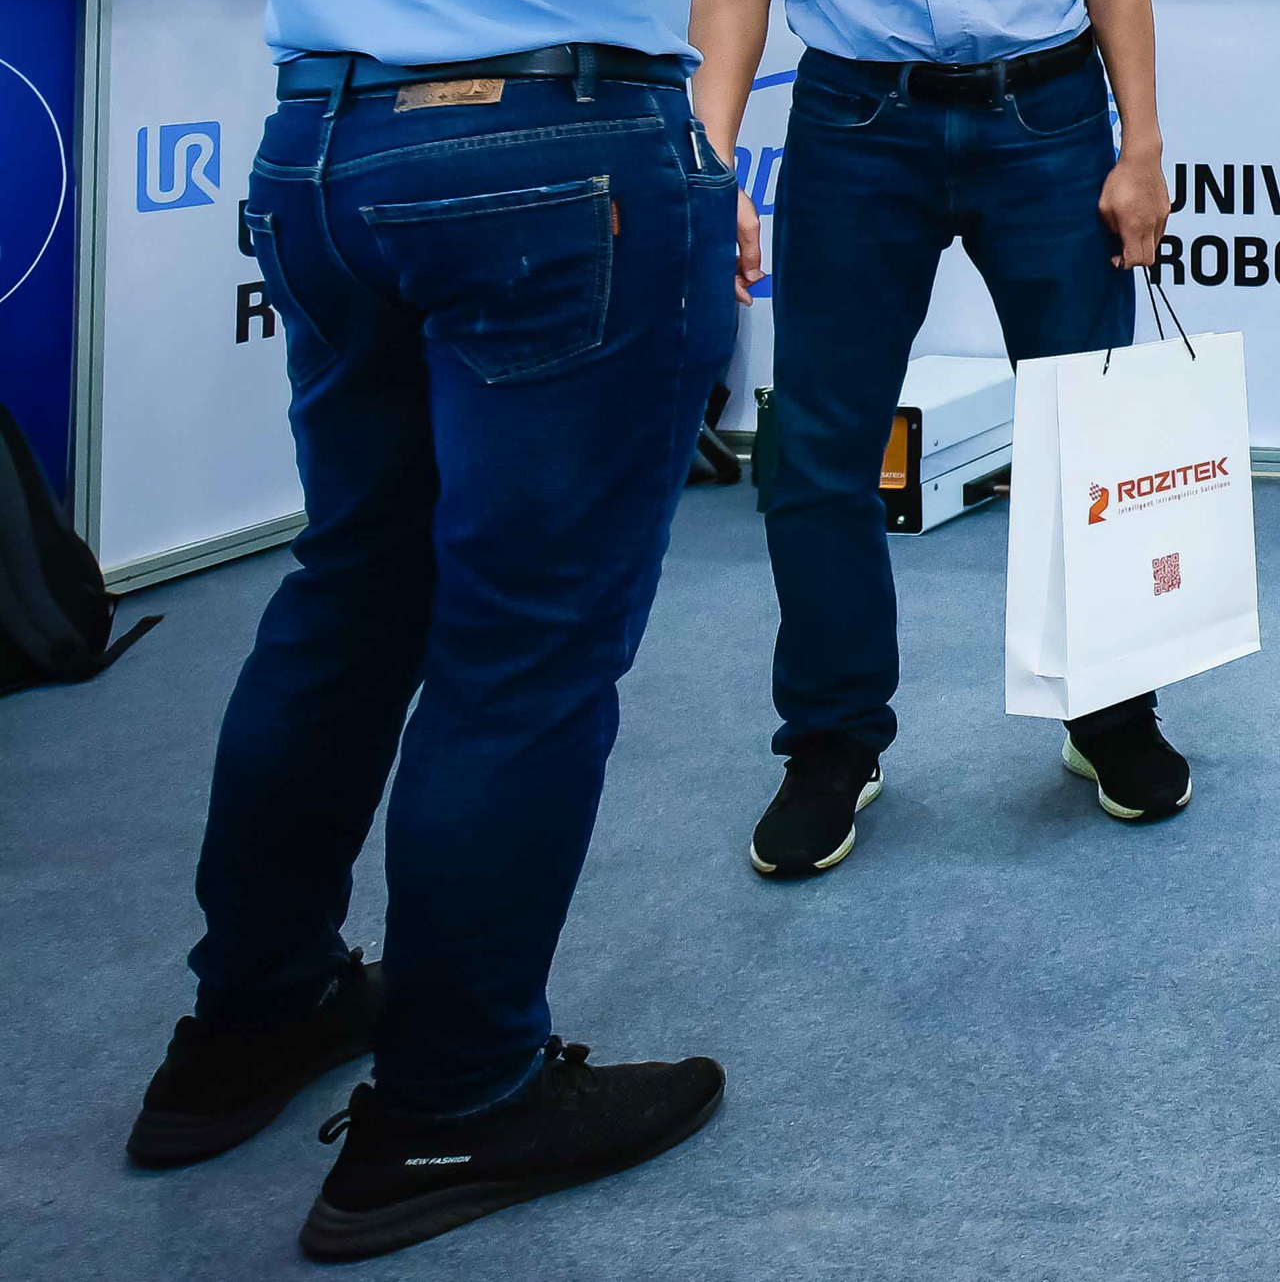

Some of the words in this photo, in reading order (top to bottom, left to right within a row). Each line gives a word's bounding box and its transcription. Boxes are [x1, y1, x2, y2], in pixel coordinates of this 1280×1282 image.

[1117, 456, 1229, 502] ROZITEK
[1118, 500, 1153, 515] Intelligent
[1200, 481, 1231, 493] Solutions
[405, 1158, 430, 1166] NEW
[428, 1155, 472, 1165] FASHION
